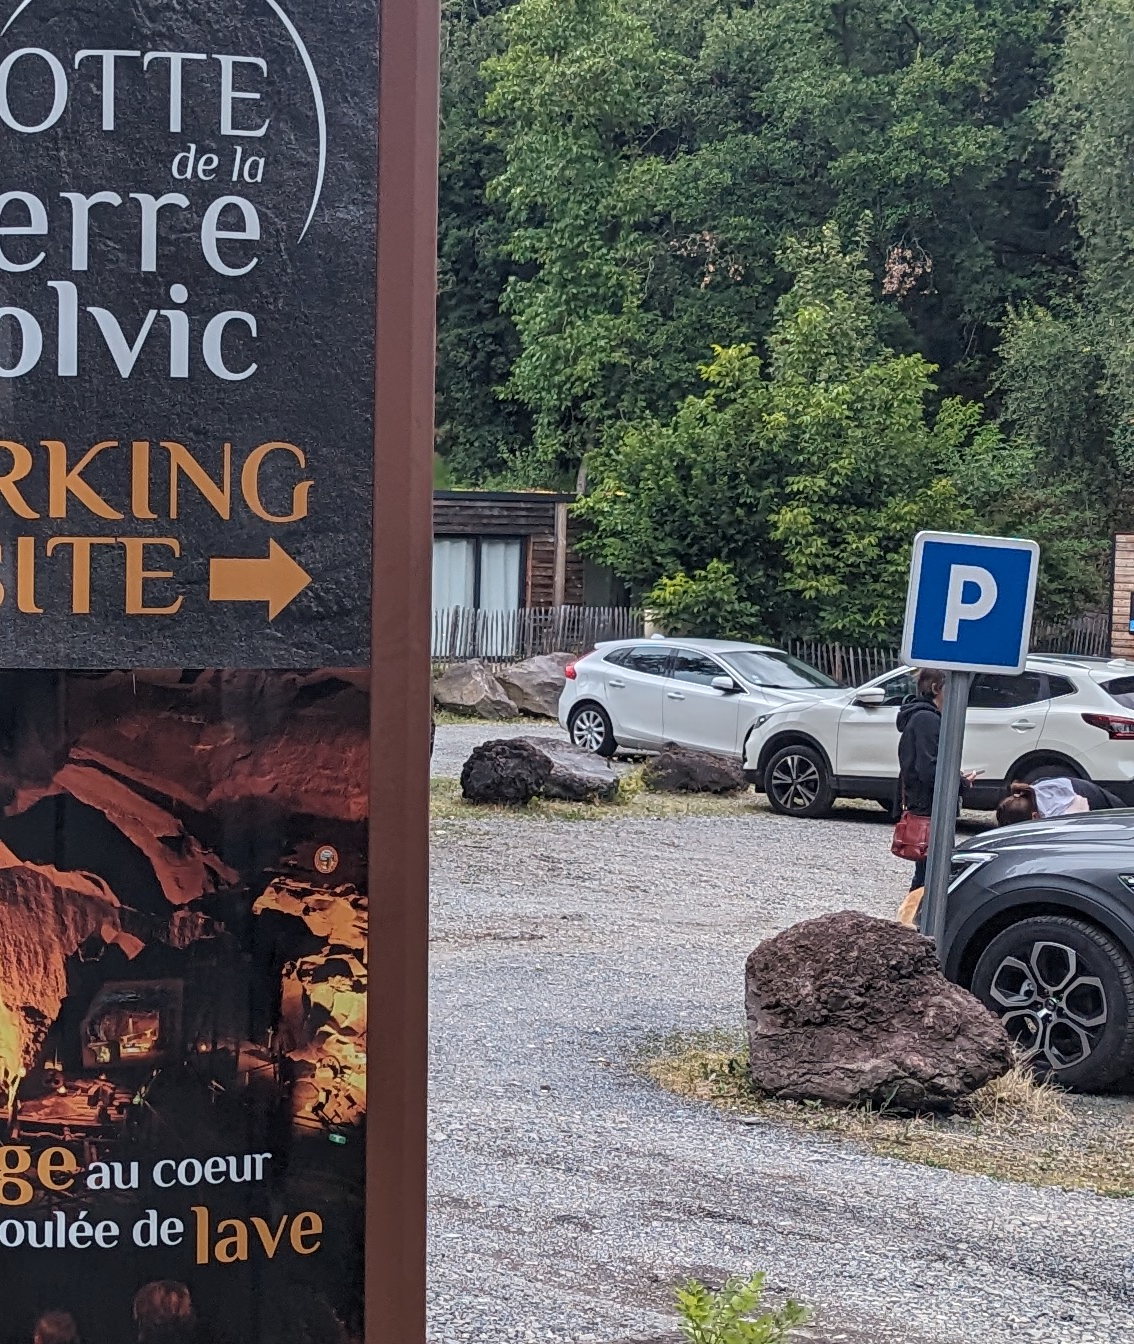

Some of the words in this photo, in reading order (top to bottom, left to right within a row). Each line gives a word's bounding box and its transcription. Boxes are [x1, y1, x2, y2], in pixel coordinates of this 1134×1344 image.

[171, 143, 219, 182] de
[231, 145, 266, 184] la
[942, 564, 998, 642] P
[86, 1160, 140, 1191] au
[152, 1151, 273, 1189] coeur
[132, 1208, 185, 1247] de
[191, 1206, 324, 1265] lave
